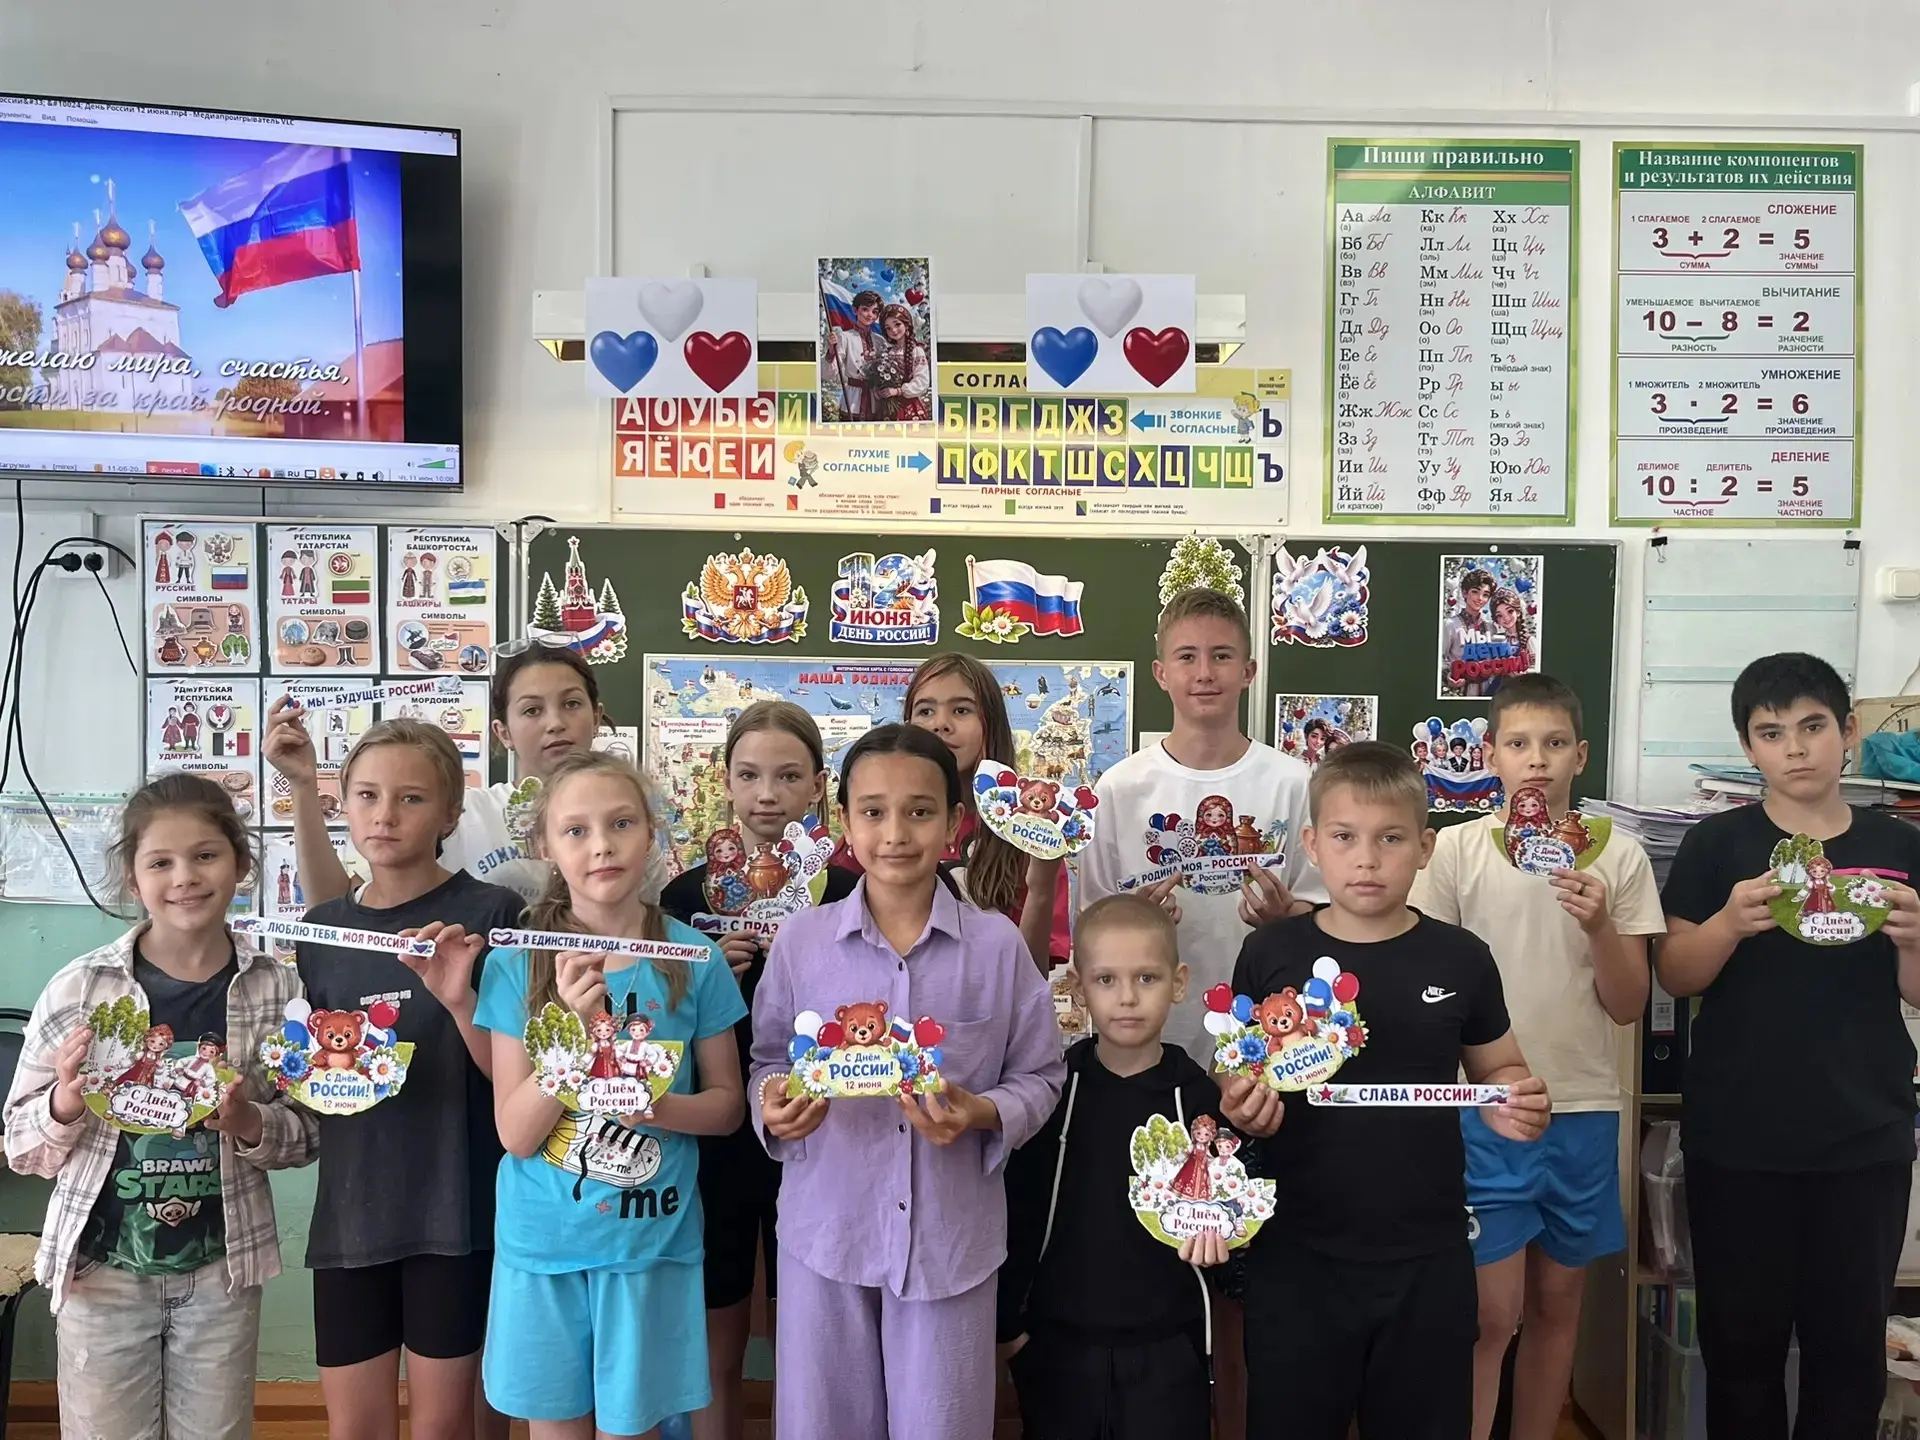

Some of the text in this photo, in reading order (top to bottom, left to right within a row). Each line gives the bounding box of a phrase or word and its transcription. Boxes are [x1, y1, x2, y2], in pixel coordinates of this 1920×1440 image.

[41, 114, 57, 122] Вид
[106, 105, 135, 113] России
[137, 106, 146, 114] 12
[282, 118, 295, 126] VLC
[1363, 147, 1544, 168] Пиши правильно
[1639, 151, 1839, 168] Название компонентов
[1624, 170, 1853, 187] и результатов их действия
[1408, 186, 1496, 199] АЛФАВИТ
[1767, 204, 1837, 216] СЛОЖЕНИЕ
[1341, 209, 1364, 223] Аа
[1421, 209, 1444, 223] Кк
[1493, 210, 1516, 224] Хх
[1637, 216, 1690, 224] СЛАГАЕМОЕ
[1708, 216, 1761, 224] СЛАГАЕМОЕ
[1779, 253, 1824, 261] ЗНАЧЕНИЕ
[1679, 261, 1711, 270] СУММА
[1784, 262, 1818, 270] СУММЫ
[1762, 287, 1840, 298] ВЫЧИТАНИЕ
[1626, 299, 1694, 307] УМЕНЬШАЕМОЕ
[1699, 299, 1761, 307] ВЫЧИТАЕМОЕ
[1778, 335, 1824, 343] ЗНАЧЕНИЕ
[1671, 344, 1717, 352] РАЗНОСТЬ
[1778, 344, 1824, 352] РАЗНОСТИ
[107, 352, 350, 386] мира, счастья,
[1761, 369, 1841, 380] УМНОЖЕНИЕ
[1635, 381, 1690, 389] МНОЖИТЕЛЬ
[1705, 381, 1761, 389] МНОЖИТЕЛЬ
[83, 387, 331, 421] за край родной.
[1170, 410, 1222, 421] ЗВОНКИЕ
[1777, 417, 1823, 425] ЗНАЧЕНИЕ
[1170, 424, 1237, 435] СОГЛАСНЫЕ
[1658, 426, 1728, 435] ПРОИЗВЕДЕНИЕ
[1765, 426, 1836, 435] ПРОИЗВЕДЕНИЯ
[848, 449, 890, 459] ГЛУХИЕ
[1771, 452, 1830, 463] ДЕЛЕНИЕ
[822, 462, 890, 473] СОГЛАСНЫЕ
[1637, 463, 1680, 471] ДЕЛИМОЕ
[1706, 463, 1752, 472] ДЕЛИТЕЛЬ
[287, 470, 300, 478] RU
[981, 487, 1082, 497] ПАРНЫЕ СОГЛАСНЫЕ
[1777, 500, 1823, 508] ЗНАЧЕНИЕ
[1673, 508, 1714, 517] ЧАСТНОЕ
[1777, 509, 1823, 517] ЧАСТНОГО
[294, 533, 351, 541] РЕСПУБЛИКА
[414, 535, 471, 543] РЕСПУБЛИКА
[406, 544, 478, 552] БАШКОРТОСТАН
[838, 553, 917, 610] 12
[176, 595, 223, 603] СИМВОЛЫ
[396, 600, 442, 608] БАШКИРЫ
[300, 608, 346, 616] СИМВОЛЫ
[421, 612, 467, 620] СИМВОЛЫ
[850, 610, 911, 626] ИЮНЯ
[838, 625, 931, 642] ДЕНЬ РОССИИ!
[799, 673, 910, 686] НАША РОДИНА
[308, 682, 435, 708] МЫ БУДУЩЕЕ РОССИИ!
[159, 753, 202, 761] УДМУРТЫ
[1033, 824, 1053, 835] Днём
[1012, 824, 1062, 848] России!
[1541, 847, 1560, 855] Днём
[1531, 853, 1562, 863] России!
[1142, 866, 1178, 884] РОДИНА
[1181, 861, 1203, 873] МОЯ
[1199, 872, 1229, 882] России!
[765, 911, 785, 920] Днём
[1812, 916, 1852, 926] С Днём
[730, 921, 739, 932] С
[1811, 926, 1854, 934] России!
[267, 922, 410, 949] ЛЮБЛЮ ТЕБЯ, МОЯ РОССИЯ!
[523, 934, 697, 957] В ЕДИНСТВЕ НАРОДА СИЛА РОССИИ!
[1428, 985, 1445, 996] NIKE
[1283, 1043, 1316, 1060] С Днём
[845, 1052, 881, 1064] С Днём
[1272, 1045, 1333, 1081] России!
[829, 1062, 894, 1080] России!
[1294, 1067, 1328, 1085] 12 июня
[325, 1073, 359, 1084] С Днём
[309, 1082, 371, 1099] России!
[592, 1083, 636, 1096] С Днём
[845, 1081, 882, 1090] 12 июня
[131, 1089, 178, 1111] С Днём
[1359, 1088, 1477, 1103] СЛАВА РОССИИ!
[323, 1099, 357, 1109] 12 июня
[589, 1096, 639, 1107] России!
[123, 1102, 177, 1123] России!
[142, 1159, 214, 1174] BRAWL
[116, 1168, 222, 1199] STARS
[619, 1186, 679, 1219] me
[1177, 1206, 1221, 1221] С Днём
[1174, 1219, 1222, 1234] России!
